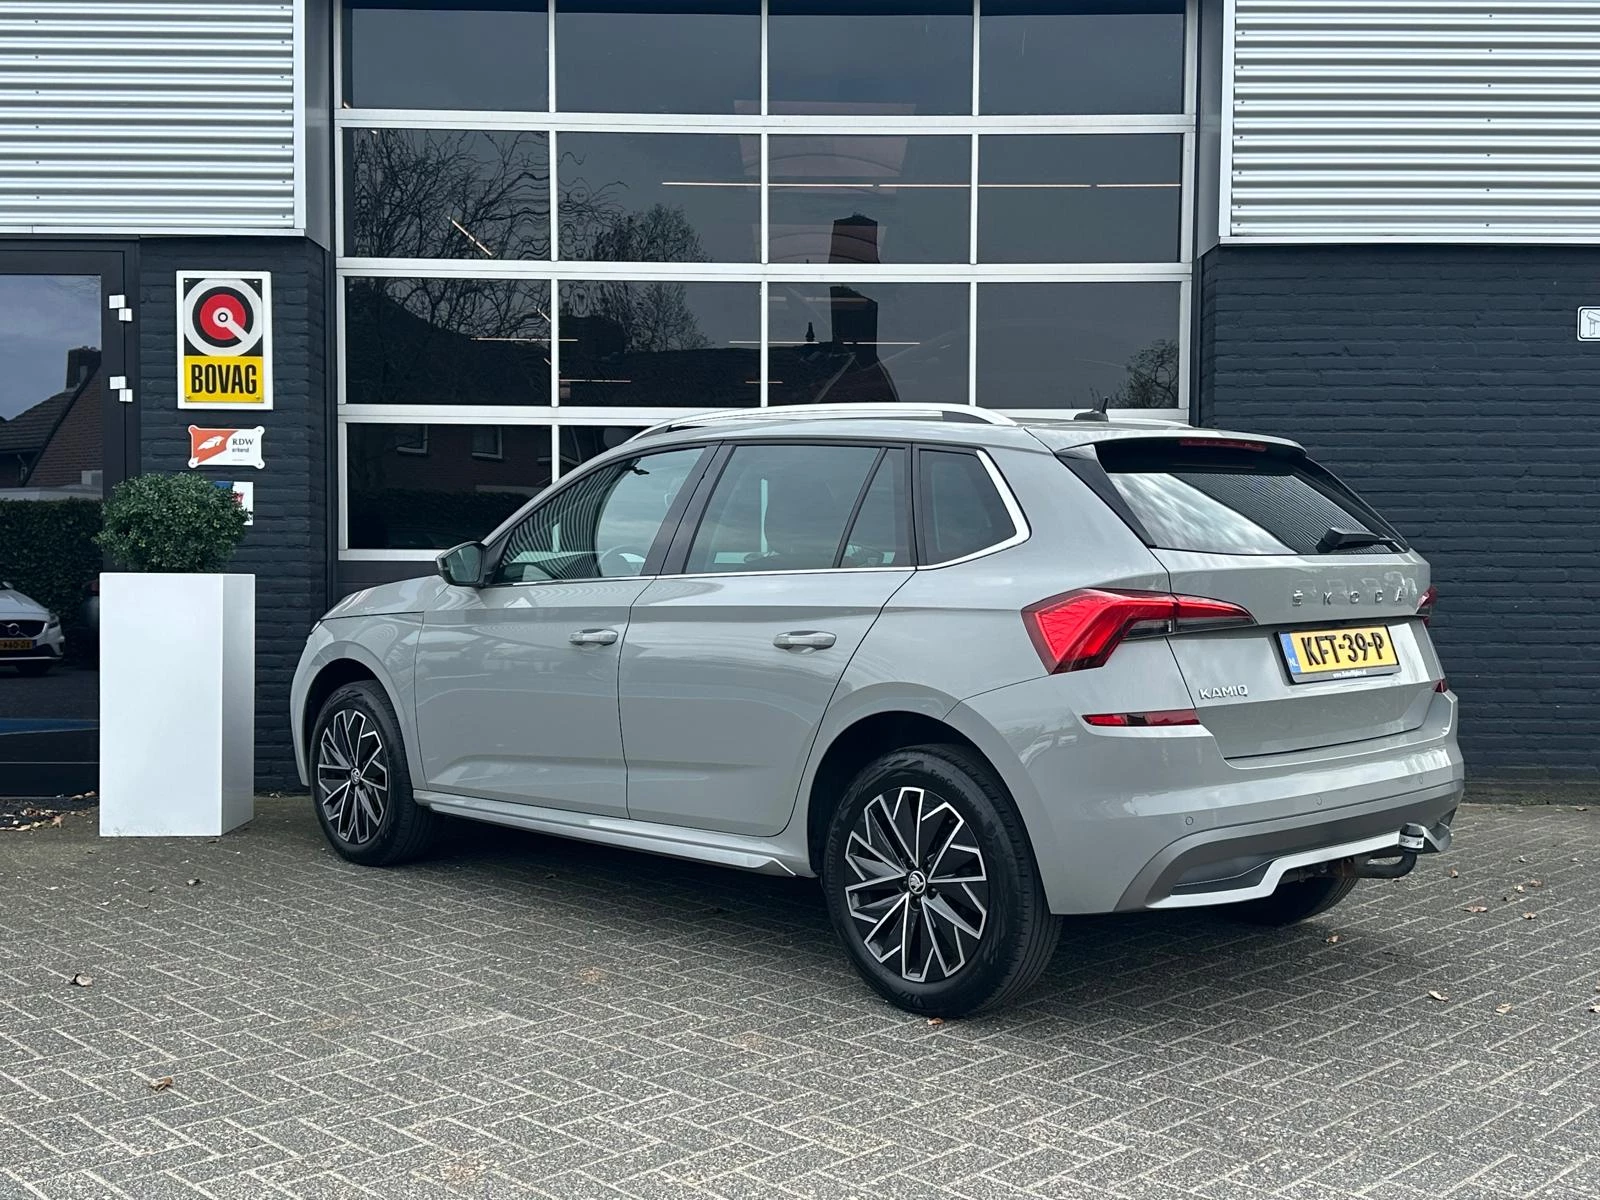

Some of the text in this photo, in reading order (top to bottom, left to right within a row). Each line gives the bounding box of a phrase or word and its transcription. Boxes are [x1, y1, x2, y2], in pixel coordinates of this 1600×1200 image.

[191, 364, 257, 394] BOVAG
[232, 438, 254, 446] RDW
[1301, 632, 1385, 666] KFT-39-P
[1199, 684, 1249, 700] KAMIQ
